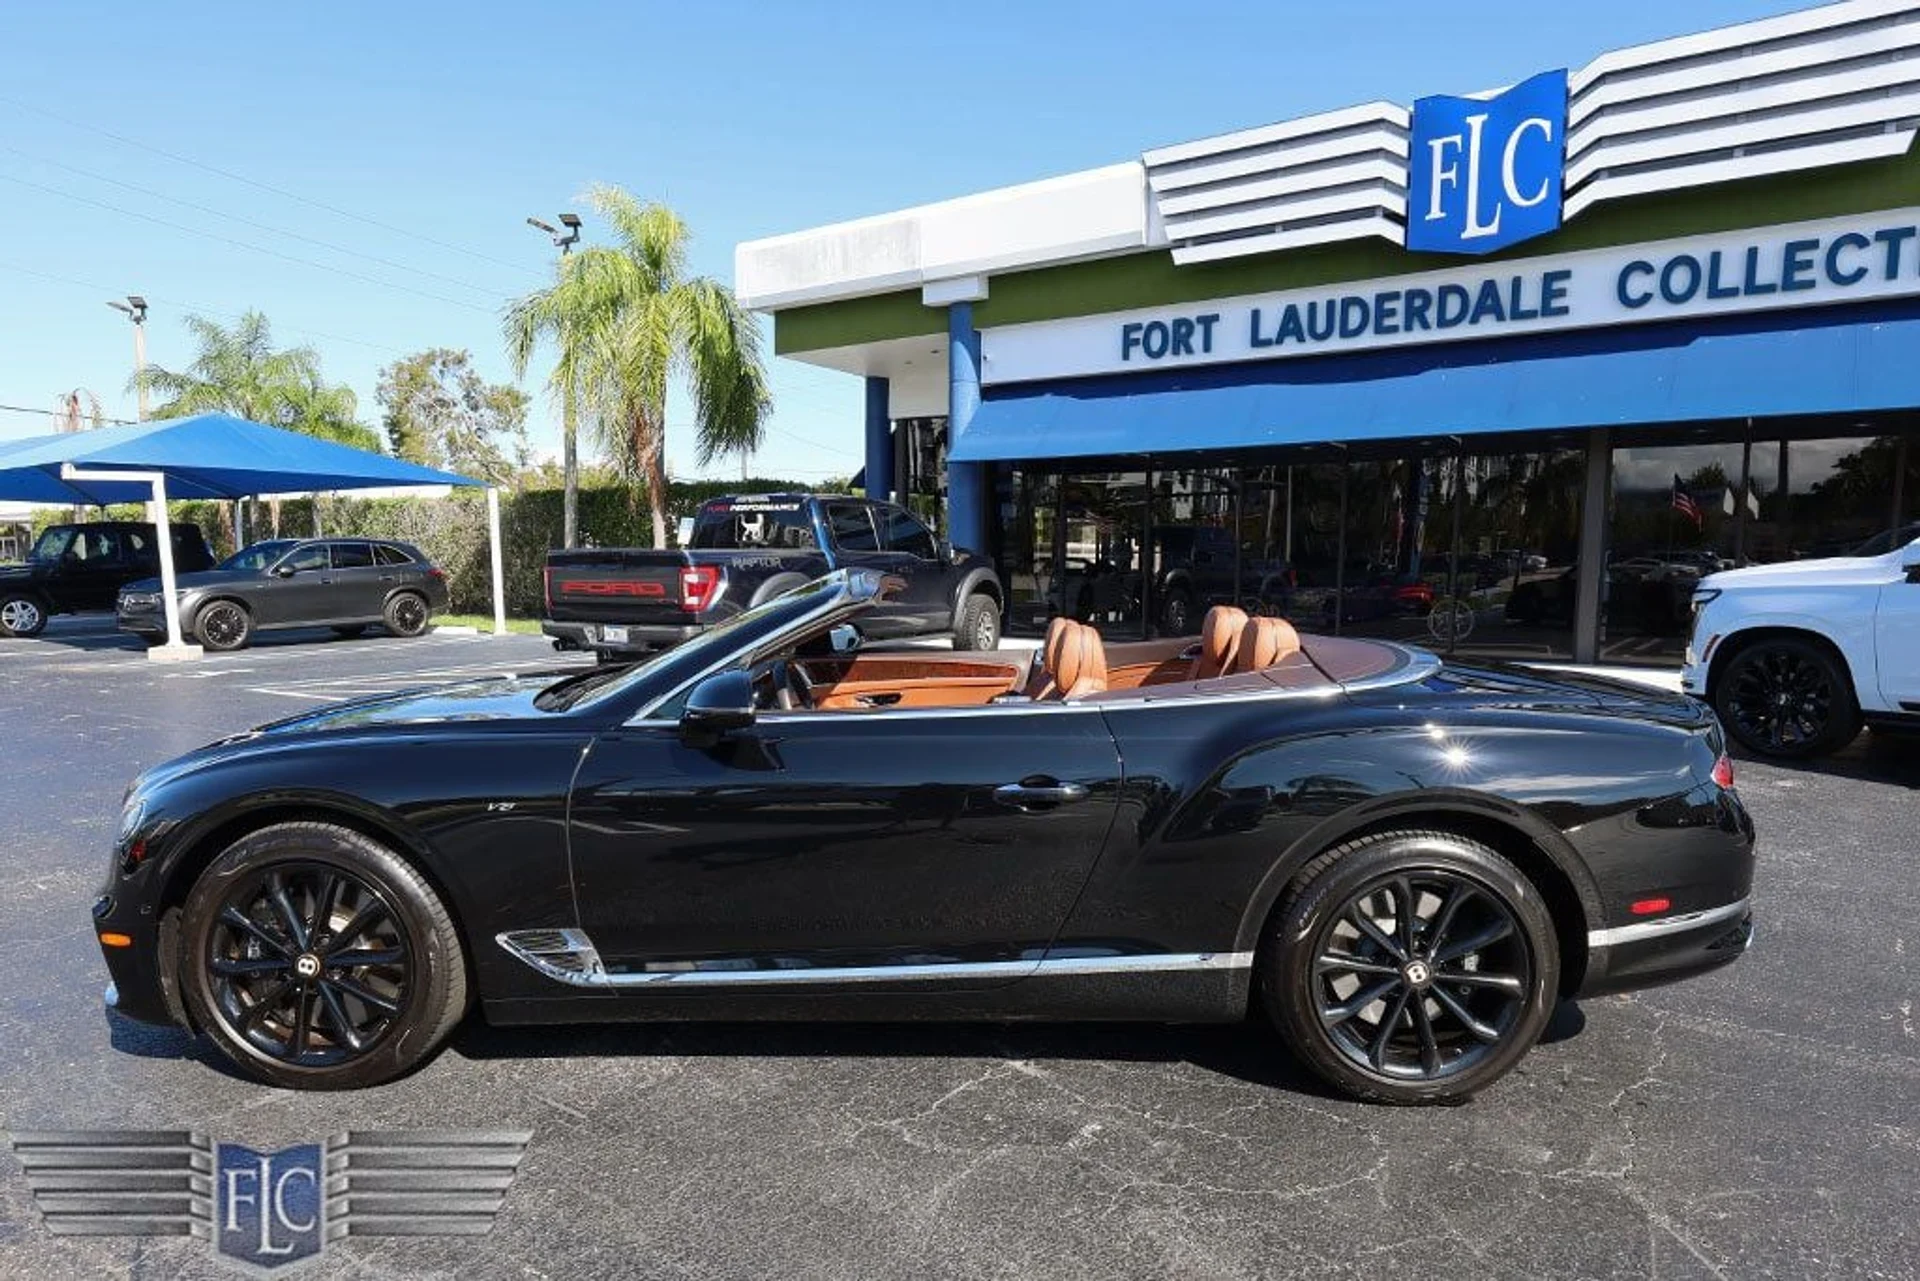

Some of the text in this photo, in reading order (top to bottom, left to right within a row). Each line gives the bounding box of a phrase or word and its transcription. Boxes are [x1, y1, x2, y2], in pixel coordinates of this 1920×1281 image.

[1425, 113, 1552, 239] FLC
[1122, 226, 1920, 361] FORT LAUDERDALE COLLECT
[729, 503, 800, 512] PERFORMANCE
[731, 556, 782, 570] RAPTOR
[560, 578, 666, 596] FORD
